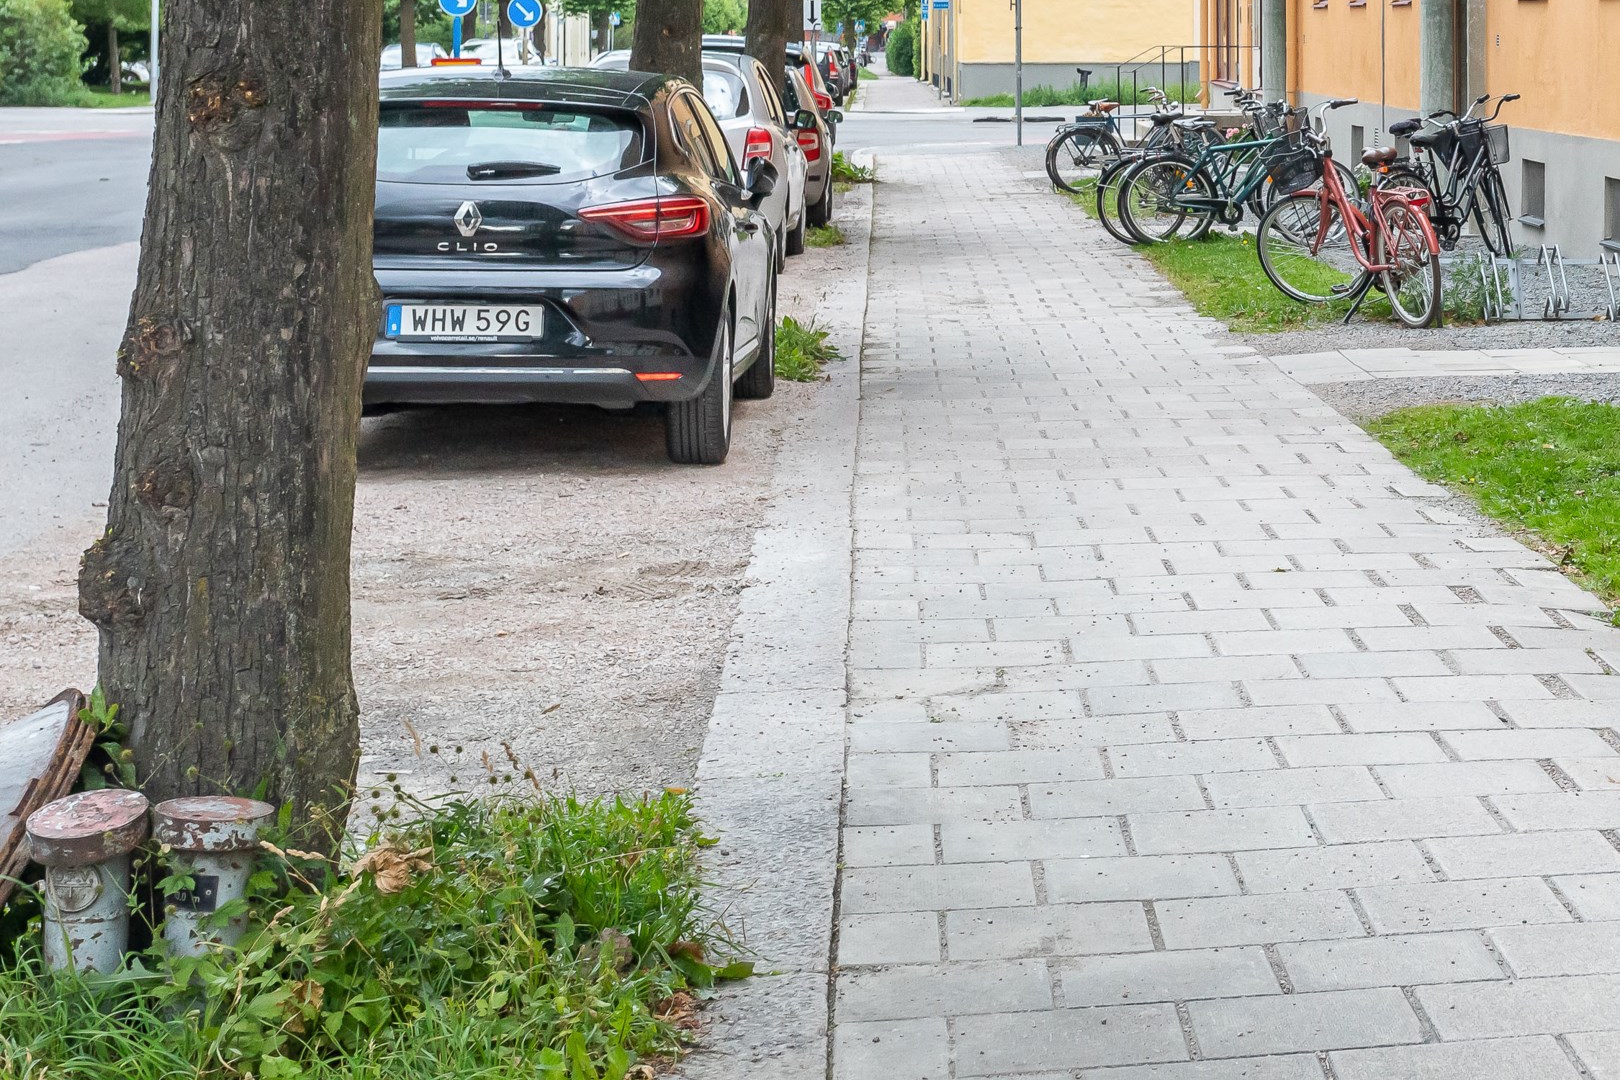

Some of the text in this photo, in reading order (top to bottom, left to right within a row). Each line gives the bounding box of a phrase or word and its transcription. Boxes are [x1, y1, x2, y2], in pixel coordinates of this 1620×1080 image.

[437, 241, 498, 252] CLIO
[412, 308, 530, 332] WHW 59G
